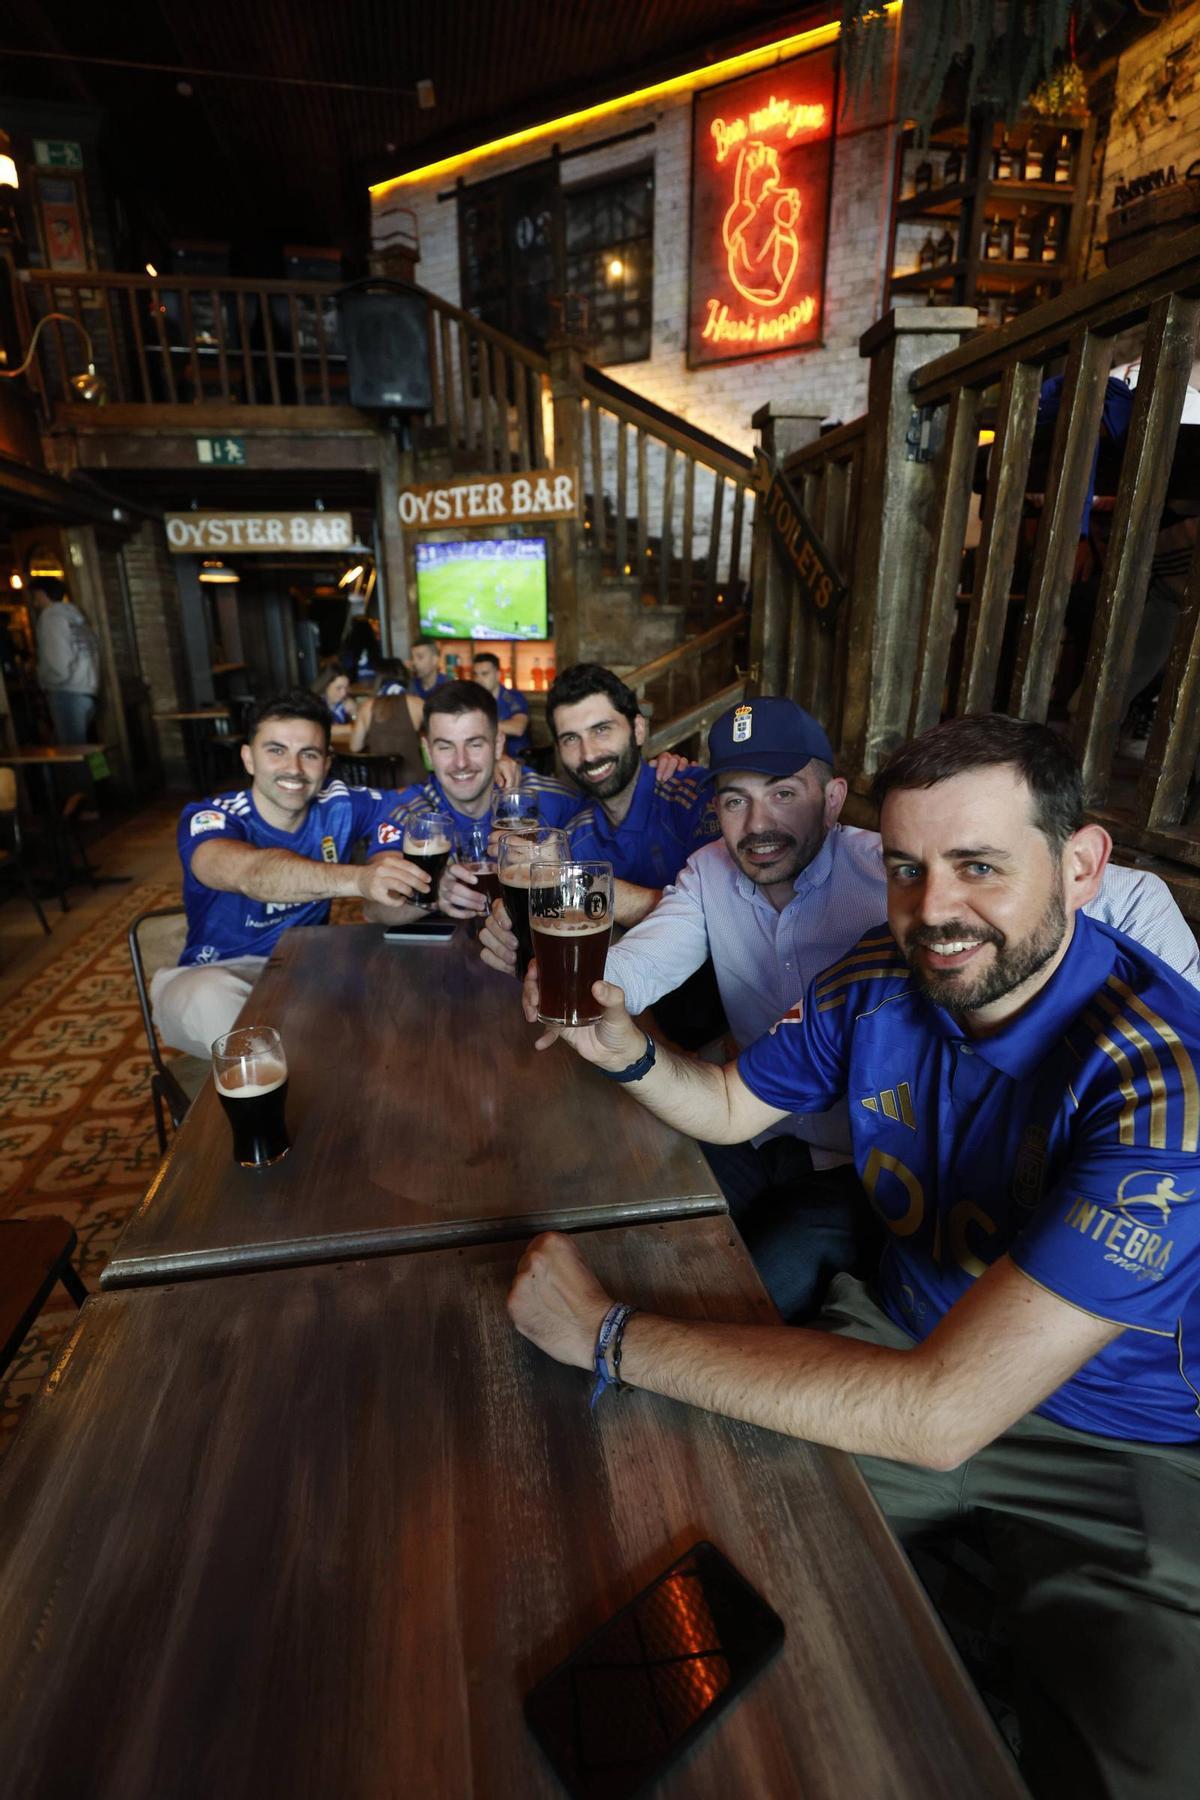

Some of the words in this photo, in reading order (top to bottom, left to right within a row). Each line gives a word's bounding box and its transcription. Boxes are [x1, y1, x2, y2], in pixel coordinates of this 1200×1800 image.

[398, 483, 507, 524] OYSTER
[511, 475, 575, 515] BAR
[166, 518, 285, 546] OYSTER
[290, 517, 349, 545] BAR
[769, 482, 832, 608] TOILETS
[1064, 1196, 1174, 1271] INTEGRA
